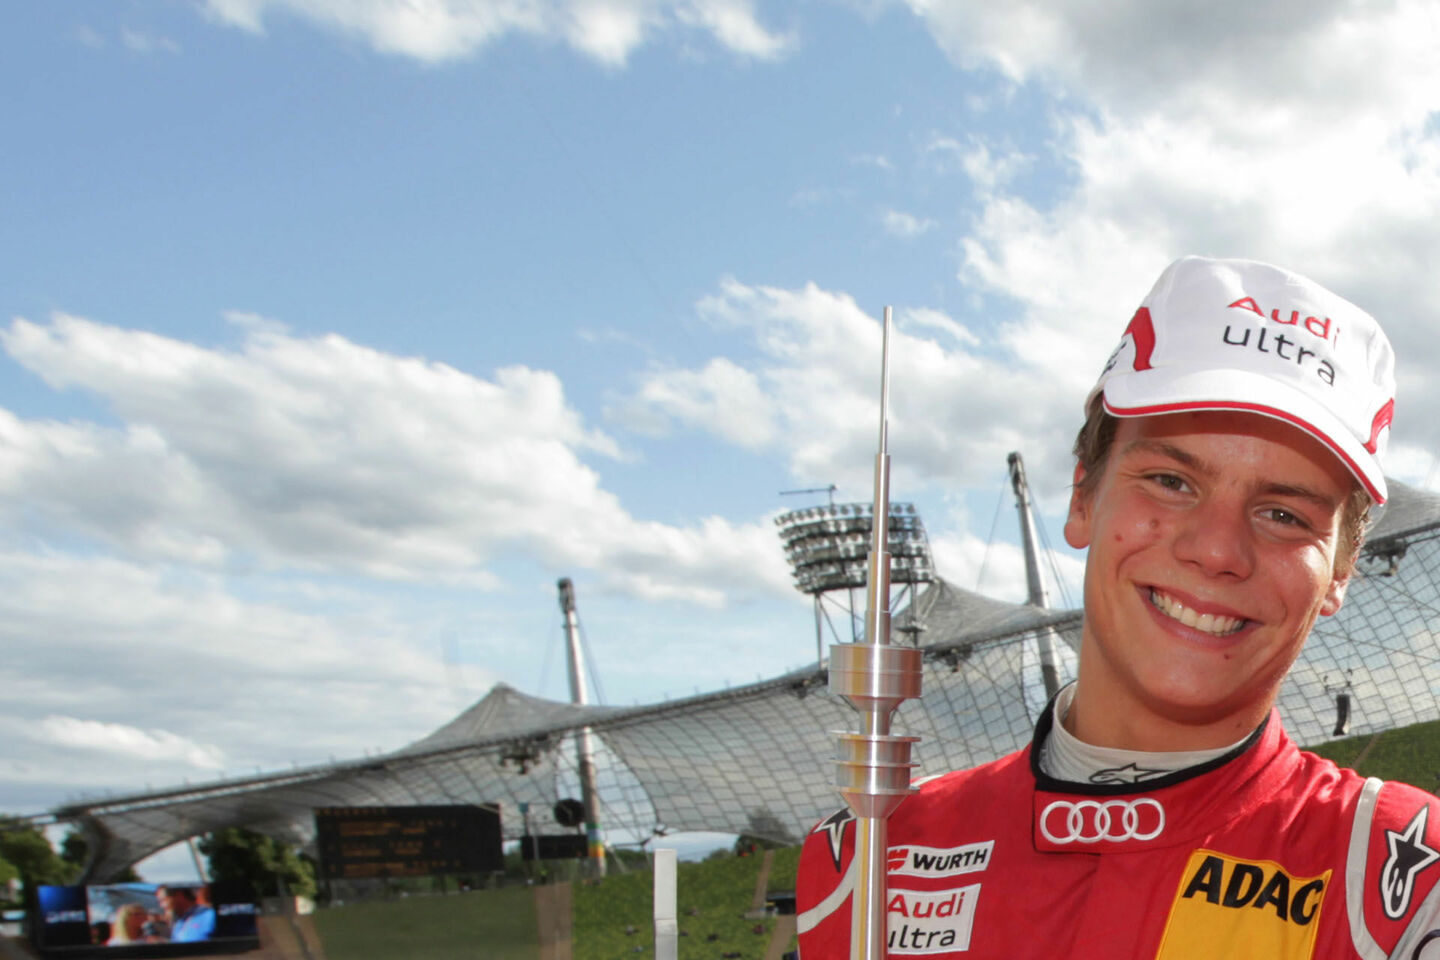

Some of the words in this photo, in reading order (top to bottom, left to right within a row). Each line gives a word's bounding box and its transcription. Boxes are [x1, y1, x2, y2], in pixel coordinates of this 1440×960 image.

[1228, 296, 1341, 349] Audi
[1222, 325, 1336, 386] ultra
[888, 891, 966, 918] Audi
[1182, 855, 1325, 926] ADAC
